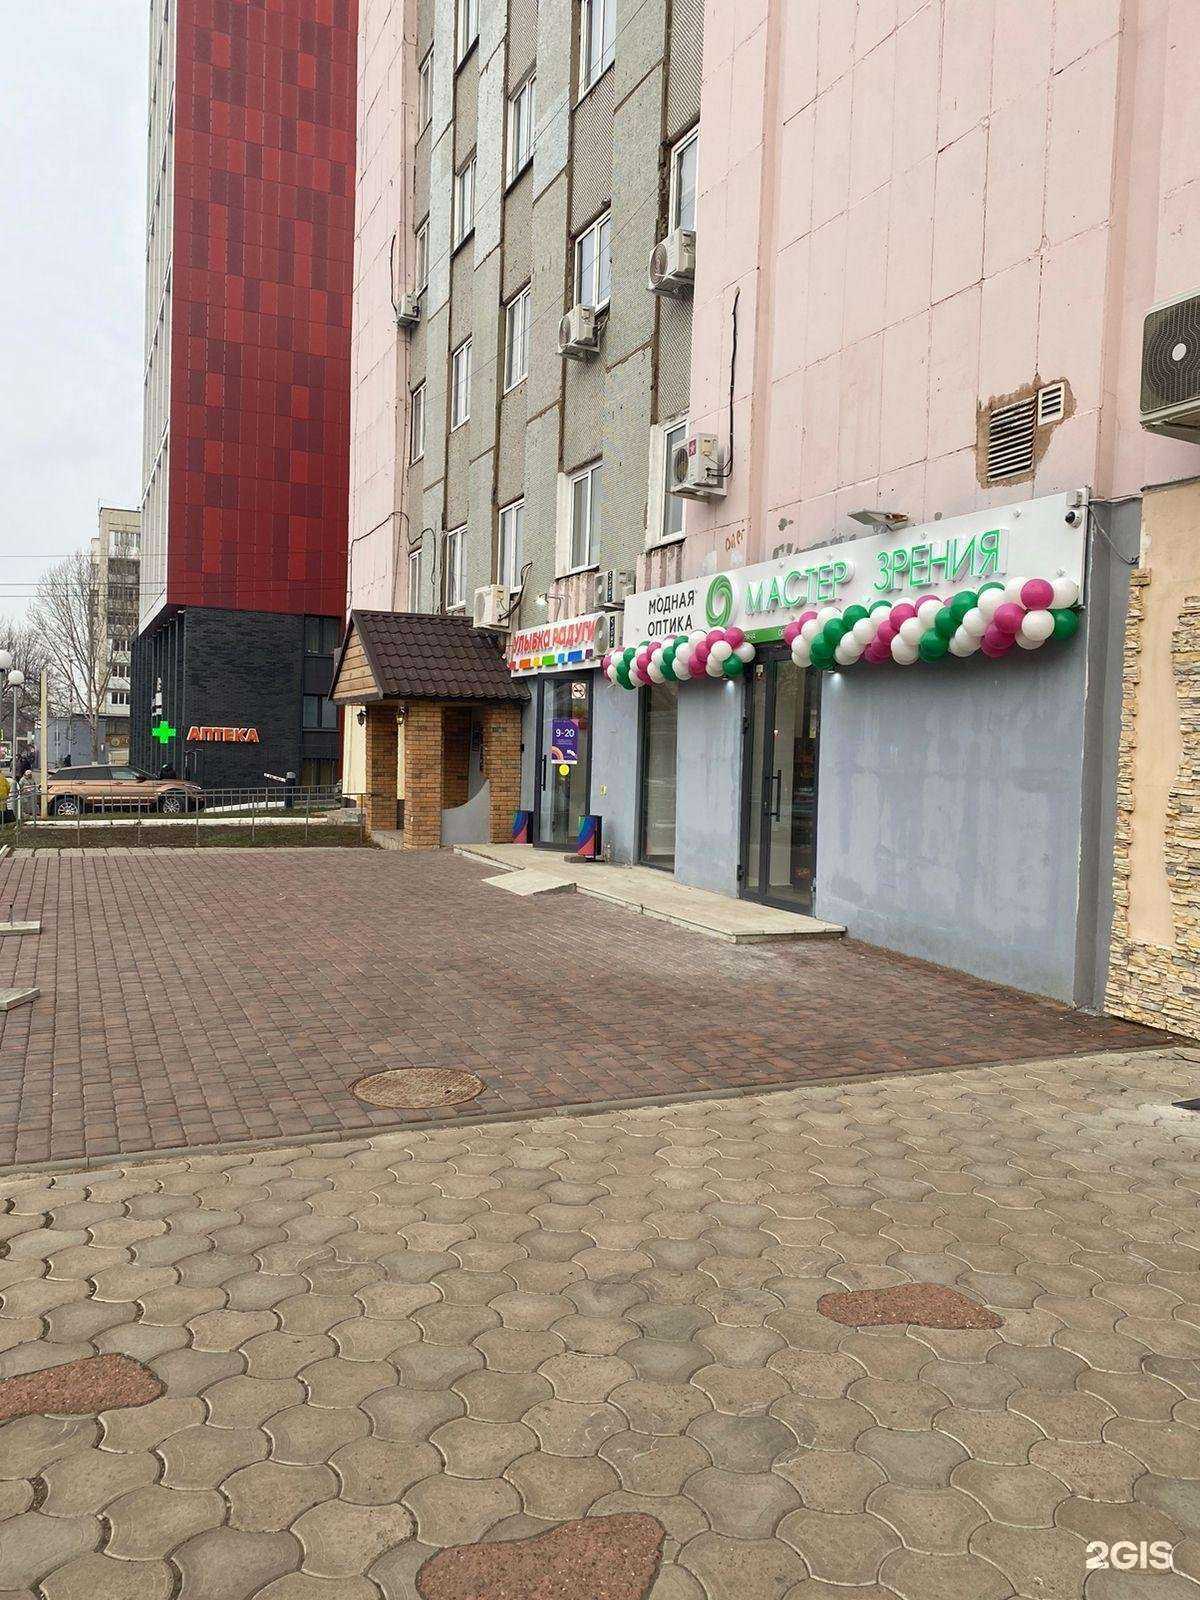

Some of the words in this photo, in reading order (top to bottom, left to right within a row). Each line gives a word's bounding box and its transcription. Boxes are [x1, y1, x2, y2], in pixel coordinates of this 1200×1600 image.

[745, 561, 848, 614] МАСТЕР
[873, 529, 1002, 591] ЗРЕНИЯ
[648, 590, 694, 615] МОДНАЯ
[647, 614, 693, 637] ОПТИКА
[187, 726, 259, 743] АПТЕКА
[555, 728, 575, 738] 9-20
